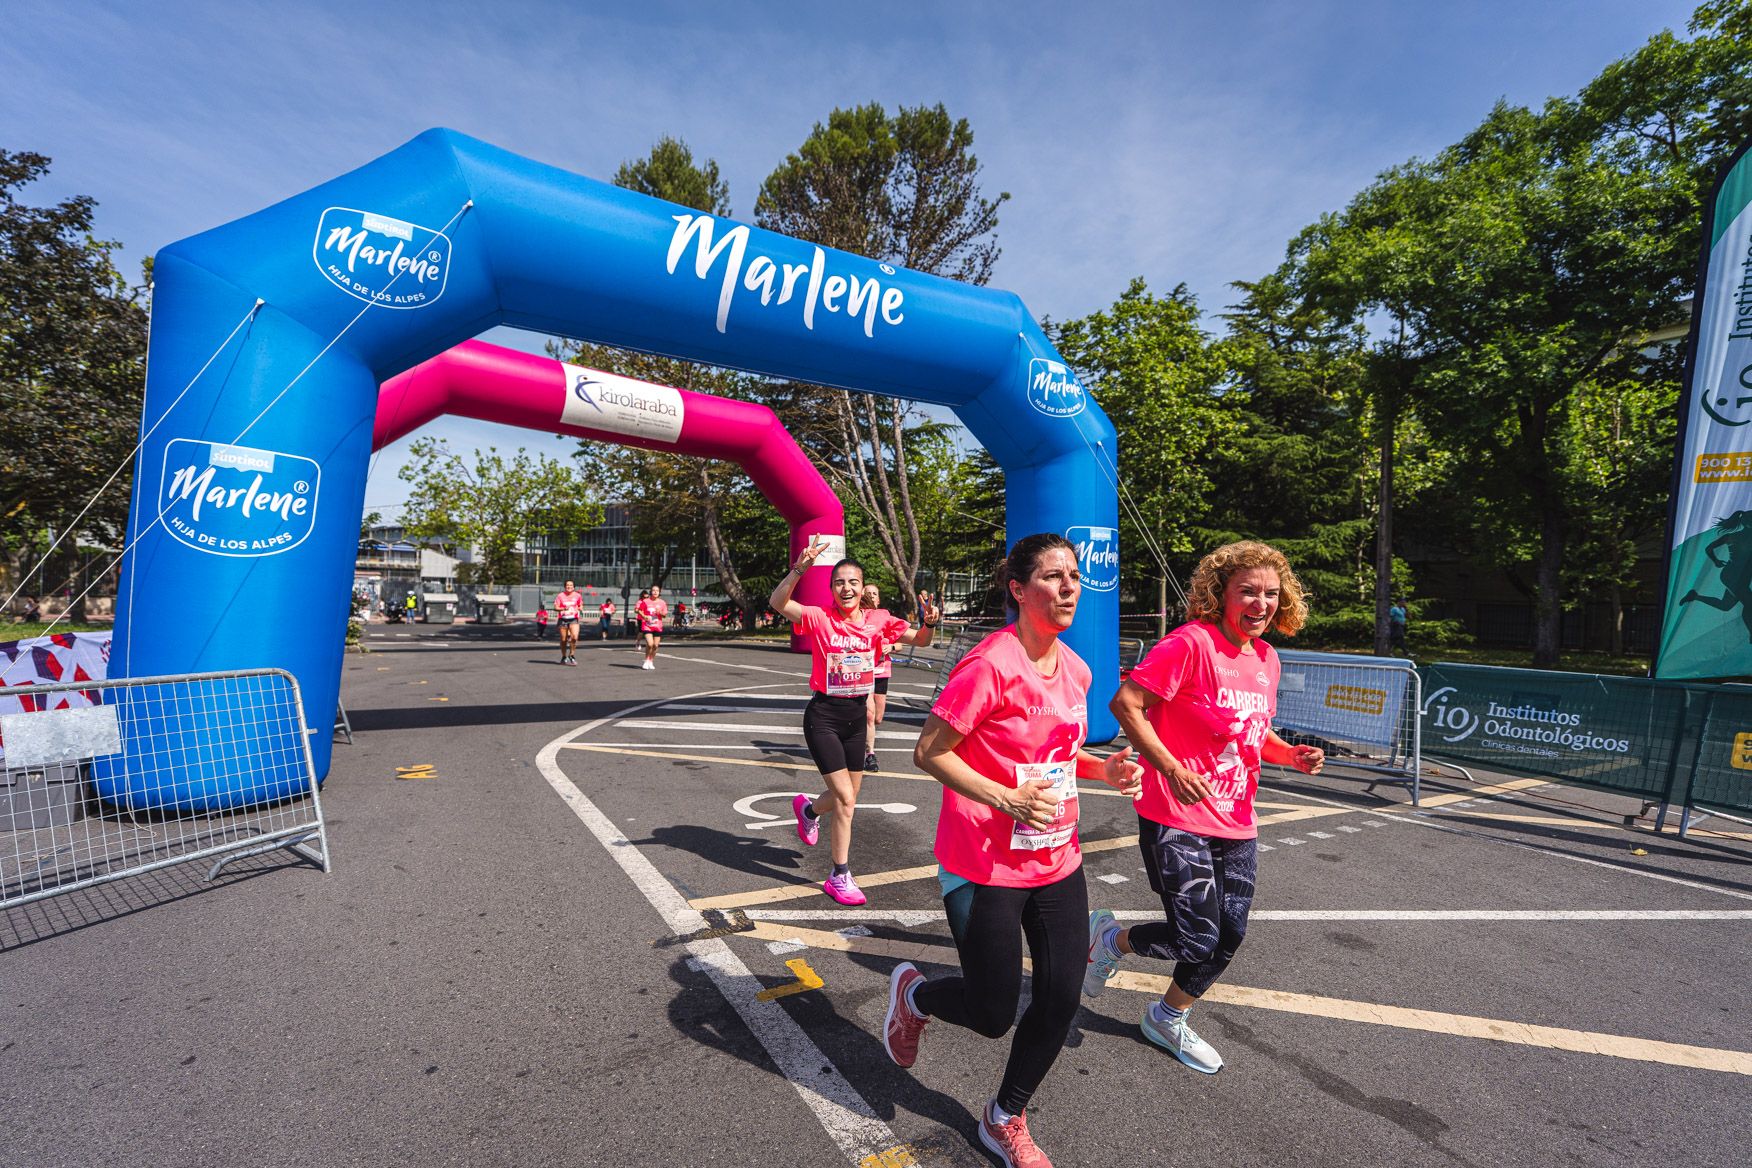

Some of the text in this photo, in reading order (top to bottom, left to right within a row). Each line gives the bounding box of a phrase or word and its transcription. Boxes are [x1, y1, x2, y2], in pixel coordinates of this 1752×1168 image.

[328, 264, 426, 303] HIJA DE LOS ALPES
[598, 386, 677, 417] kirolaraba
[1700, 466, 1752, 478] www.i
[1701, 458, 1731, 468] 900
[171, 516, 293, 550] HIJA DE LOS ALPES
[1486, 702, 1581, 726] Institutos
[1484, 719, 1630, 752] Odontológicos
[1516, 742, 1559, 758] dentales
